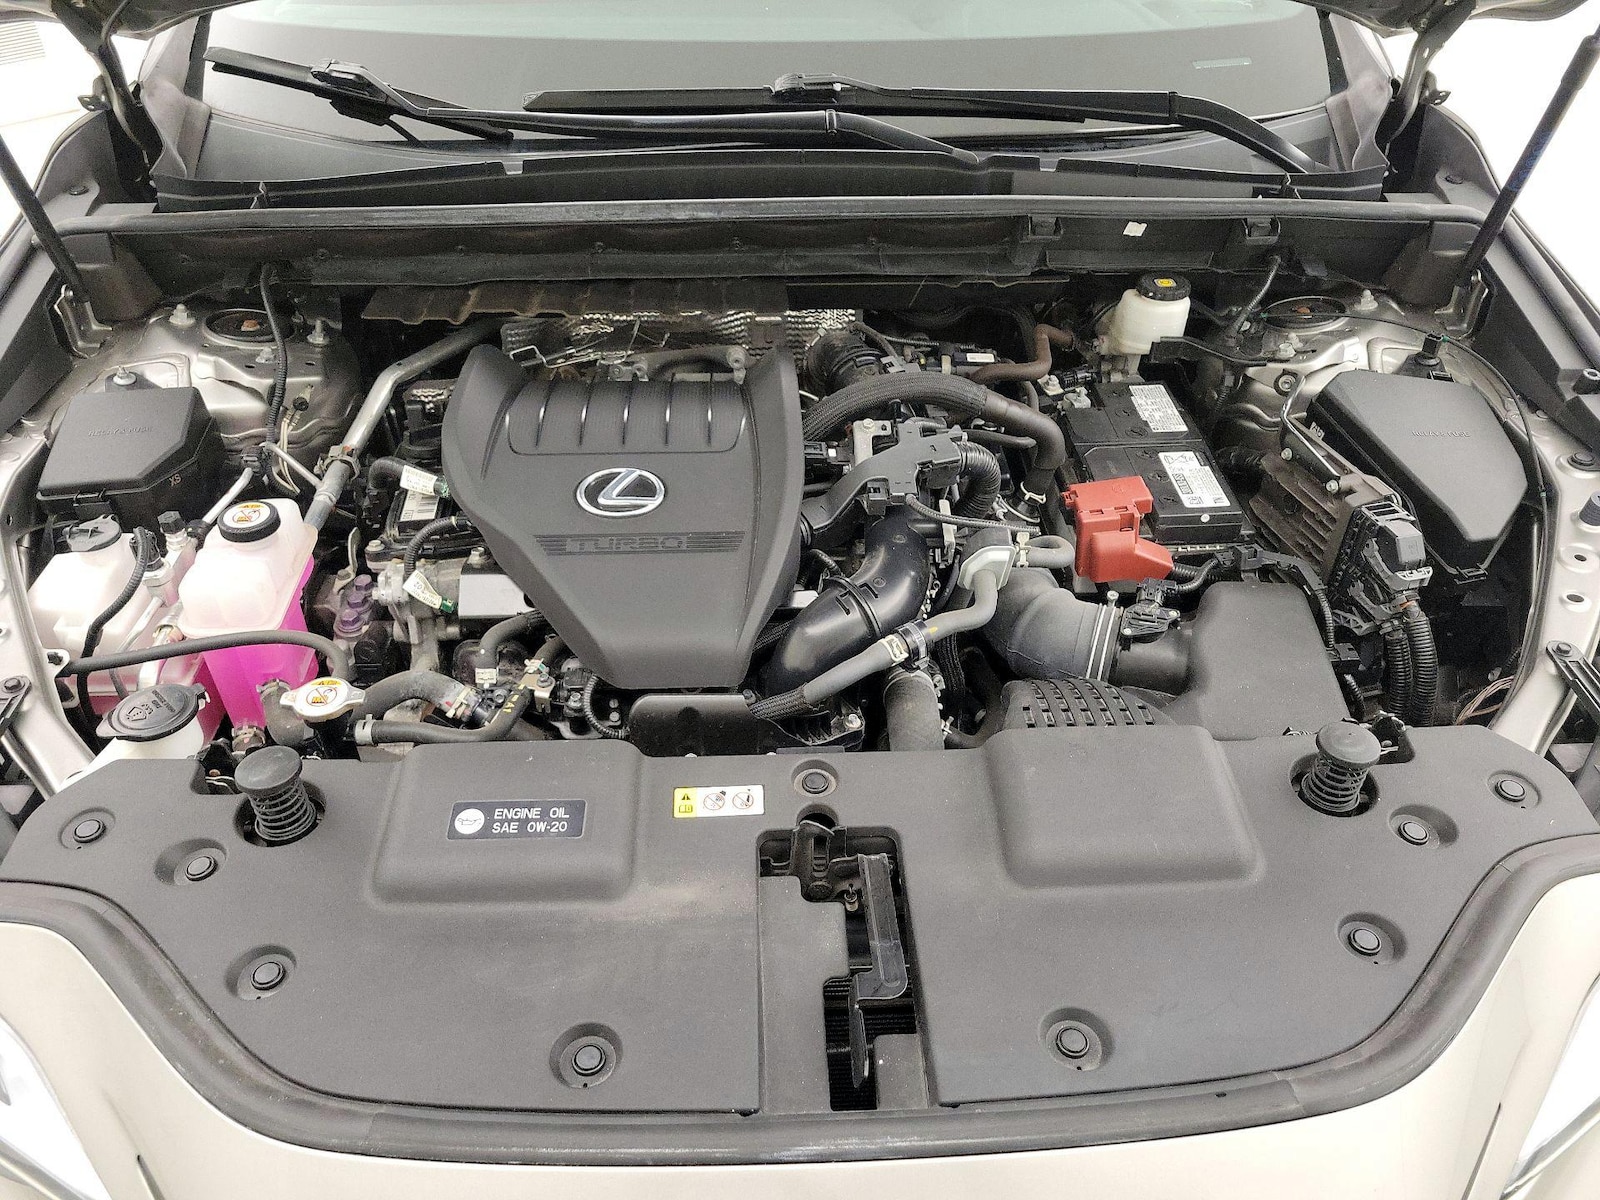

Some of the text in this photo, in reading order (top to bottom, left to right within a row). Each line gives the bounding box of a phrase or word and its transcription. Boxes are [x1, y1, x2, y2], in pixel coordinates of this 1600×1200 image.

[570, 535, 683, 551] TURBO
[493, 806, 570, 820] ENGINE OIL
[491, 820, 568, 834] SAE 0W-20
